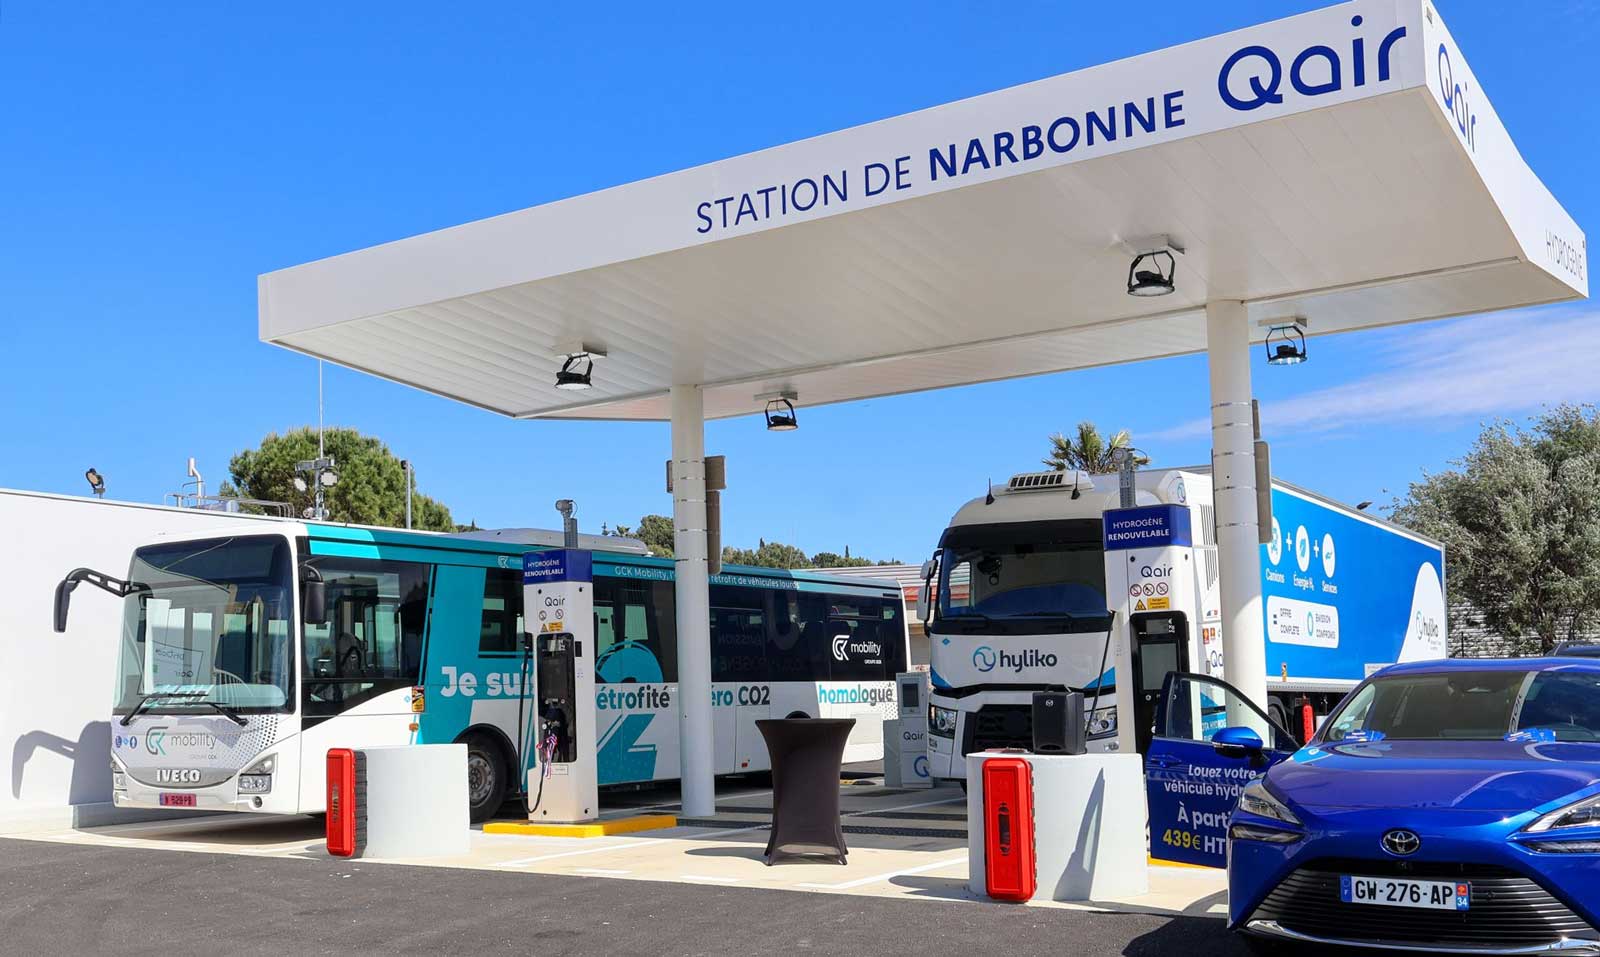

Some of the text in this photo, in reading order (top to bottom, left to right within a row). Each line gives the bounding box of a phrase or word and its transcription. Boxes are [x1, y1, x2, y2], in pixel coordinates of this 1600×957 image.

[1218, 15, 1407, 111] Qair
[1438, 43, 1476, 153] Qair
[697, 90, 1186, 234] STATION DE NARBONNE
[1108, 529, 1170, 541] RENOUVELABLE
[524, 568, 564, 577] RENOUVELABLE
[615, 566, 633, 576] GCK
[738, 576, 748, 585] de
[1141, 564, 1173, 577] Qair
[544, 595, 565, 607] Qair
[850, 641, 881, 656] mobility
[1000, 649, 1057, 673] hyliko
[440, 666, 478, 697] Je
[486, 663, 535, 696] sui
[596, 685, 671, 710] étrofité
[711, 684, 734, 706] éro
[738, 686, 770, 706] CO2
[171, 732, 218, 750] mobility
[903, 730, 925, 741] Qair
[157, 769, 201, 783] IVECO
[1188, 764, 1257, 780] Louez votre
[1164, 780, 1244, 800] véhicule hydr
[1178, 801, 1189, 823] À
[1163, 829, 1226, 855] 439€ HT
[1355, 880, 1453, 905] GW-276-AP
[1457, 897, 1468, 906] 34
